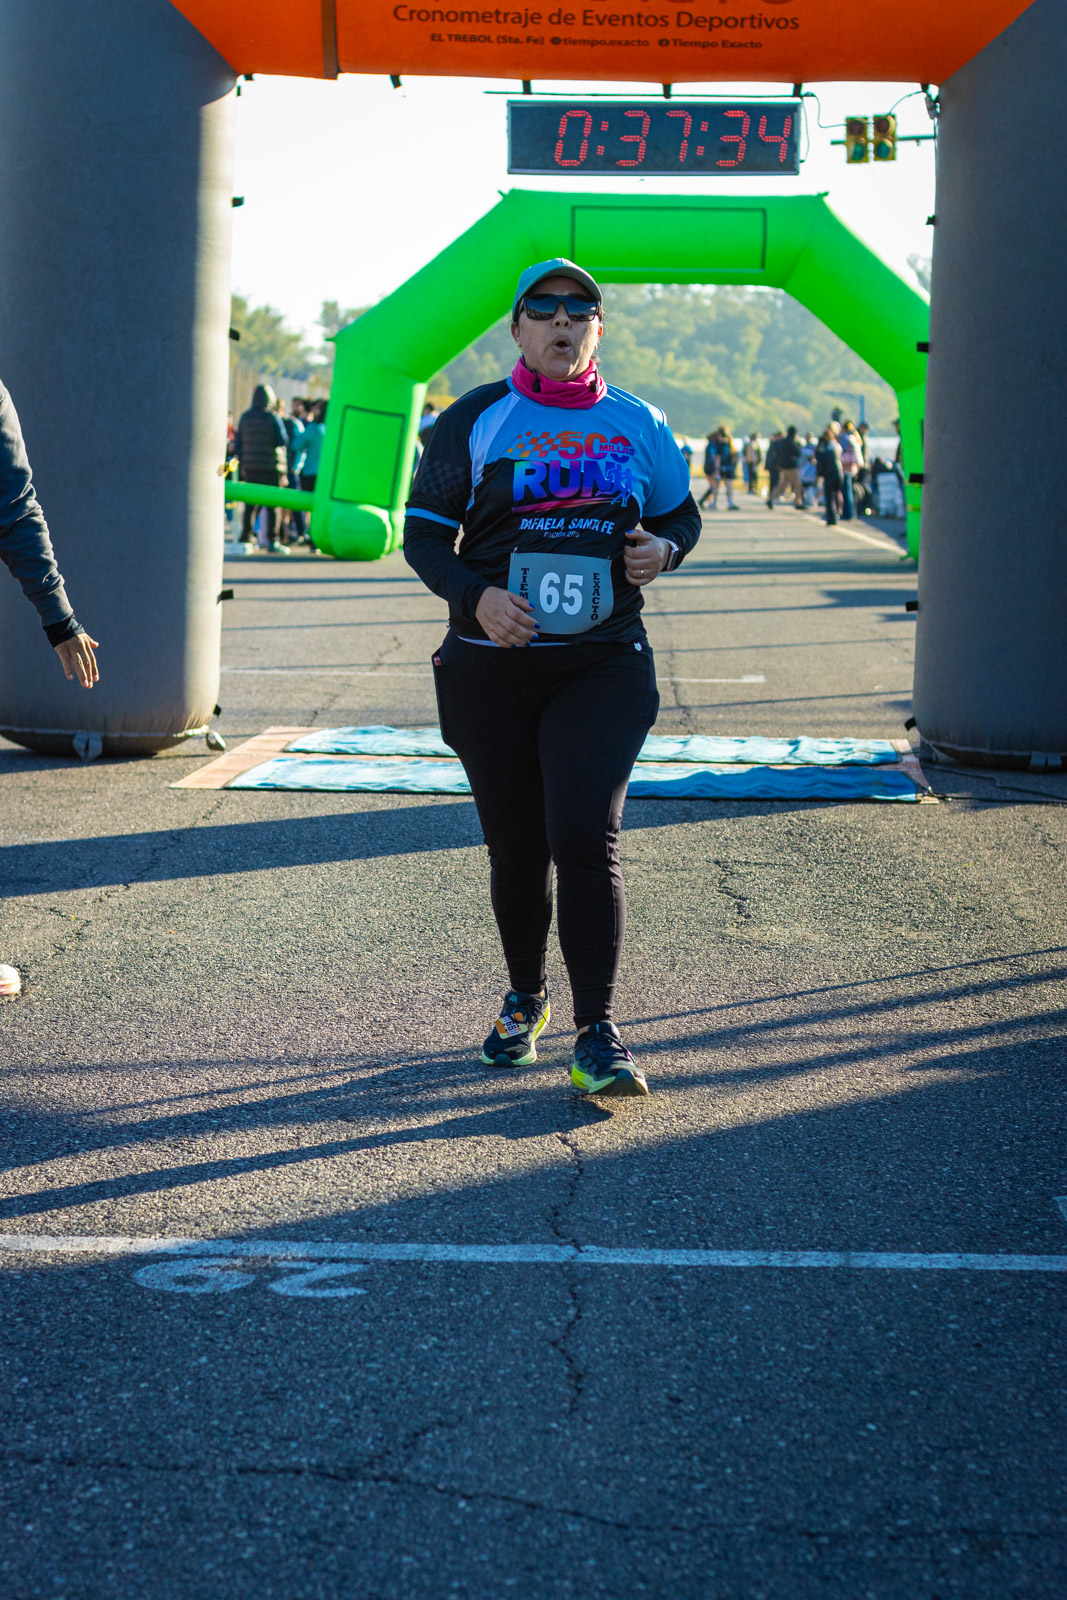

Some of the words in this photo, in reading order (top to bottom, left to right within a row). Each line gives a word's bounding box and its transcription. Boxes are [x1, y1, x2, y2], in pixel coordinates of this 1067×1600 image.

[393, 4, 542, 28] Cronometraje
[549, 8, 576, 25] de
[583, 9, 669, 27] Eventos
[676, 11, 799, 31] Deportivos
[430, 33, 444, 42] EL
[447, 34, 493, 43] TREBOL
[496, 35, 523, 45] (Sta.
[526, 36, 544, 45] Fe)
[563, 37, 649, 48] tiempo.exacto
[671, 38, 719, 49] Tiempo
[722, 40, 763, 49] Exacto
[555, 110, 792, 167] 0:37:34
[600, 443, 635, 456] MILLAS
[512, 460, 619, 502] RUN
[568, 518, 601, 531] SANTA
[601, 521, 615, 535] FE
[539, 572, 583, 615] 65
[591, 572, 600, 621] EXACTO
